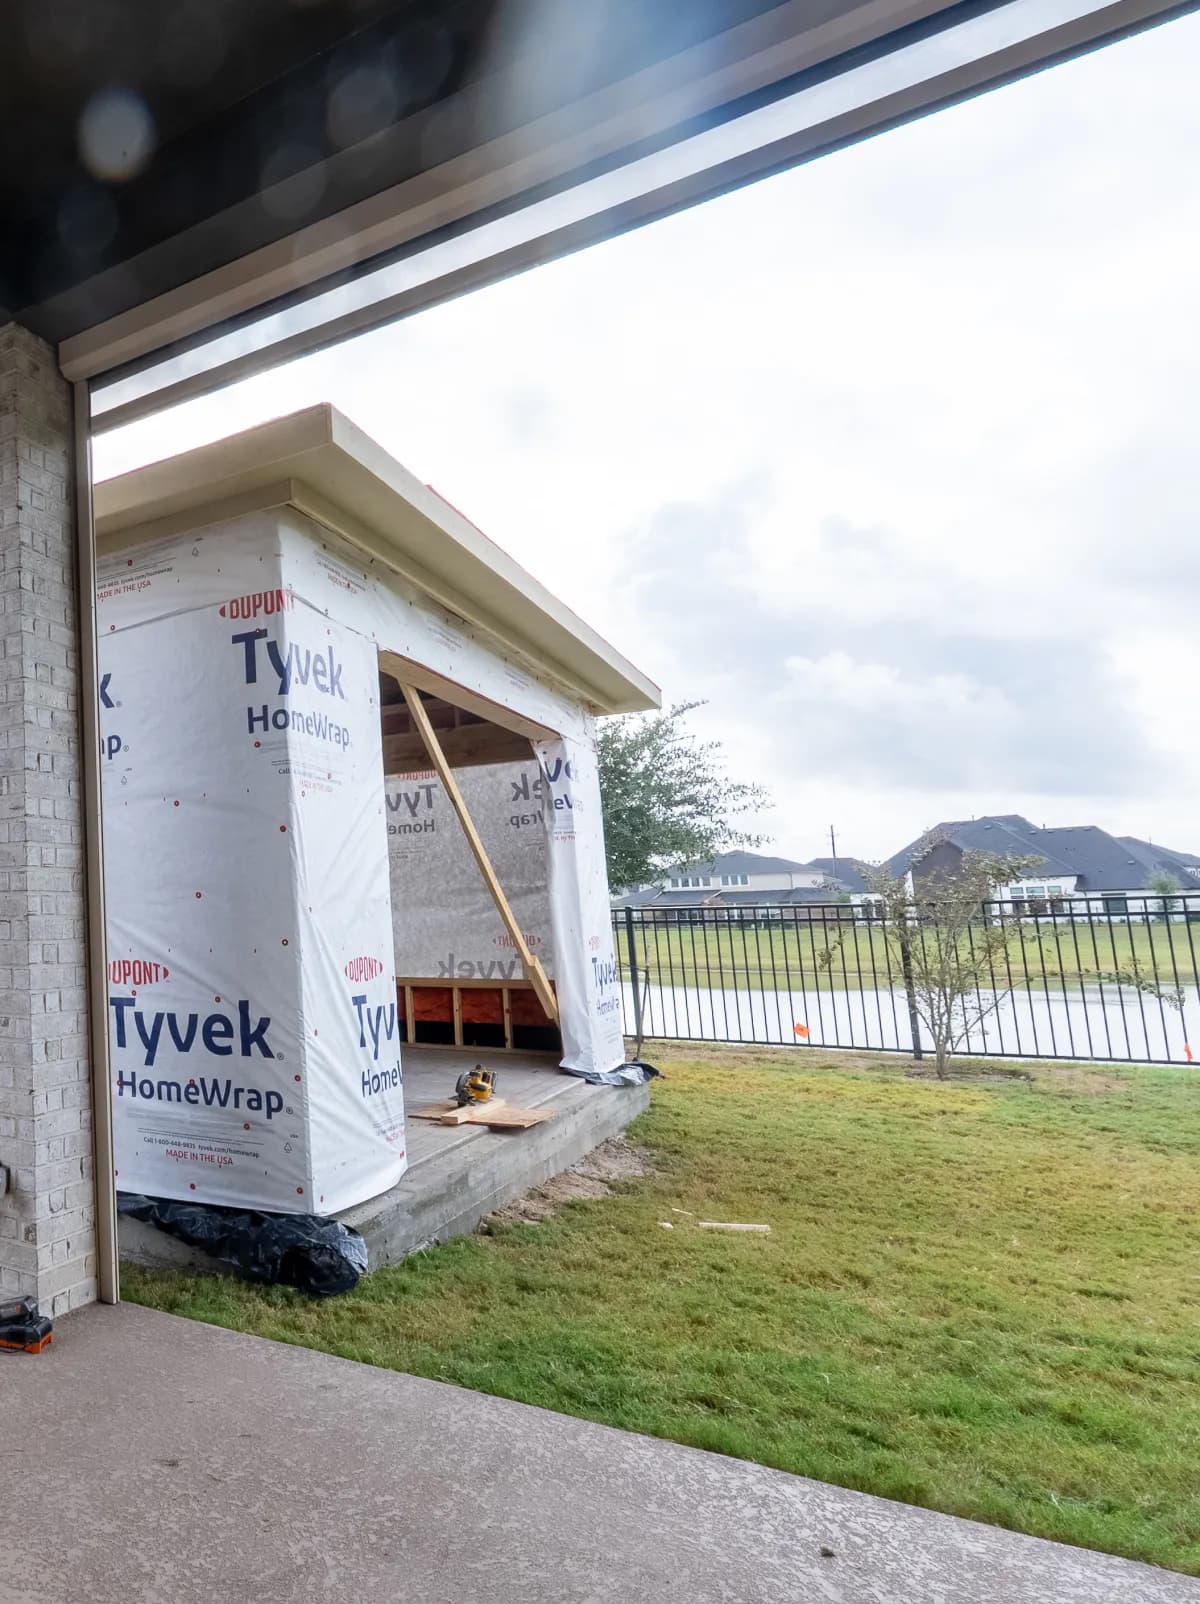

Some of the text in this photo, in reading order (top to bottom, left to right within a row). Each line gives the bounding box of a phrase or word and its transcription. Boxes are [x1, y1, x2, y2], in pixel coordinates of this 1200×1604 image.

[114, 587, 121, 596] IN
[123, 583, 136, 593] THE
[137, 579, 152, 590] USA
[232, 628, 345, 700] Tyvek
[247, 704, 350, 753] HomeWrap
[109, 960, 161, 985] UPONT
[349, 956, 378, 983] DUPONT
[110, 997, 275, 1066] Tyvek
[118, 1070, 284, 1120] HomeWrap
[166, 1149, 234, 1167] MADE IN THE USA
